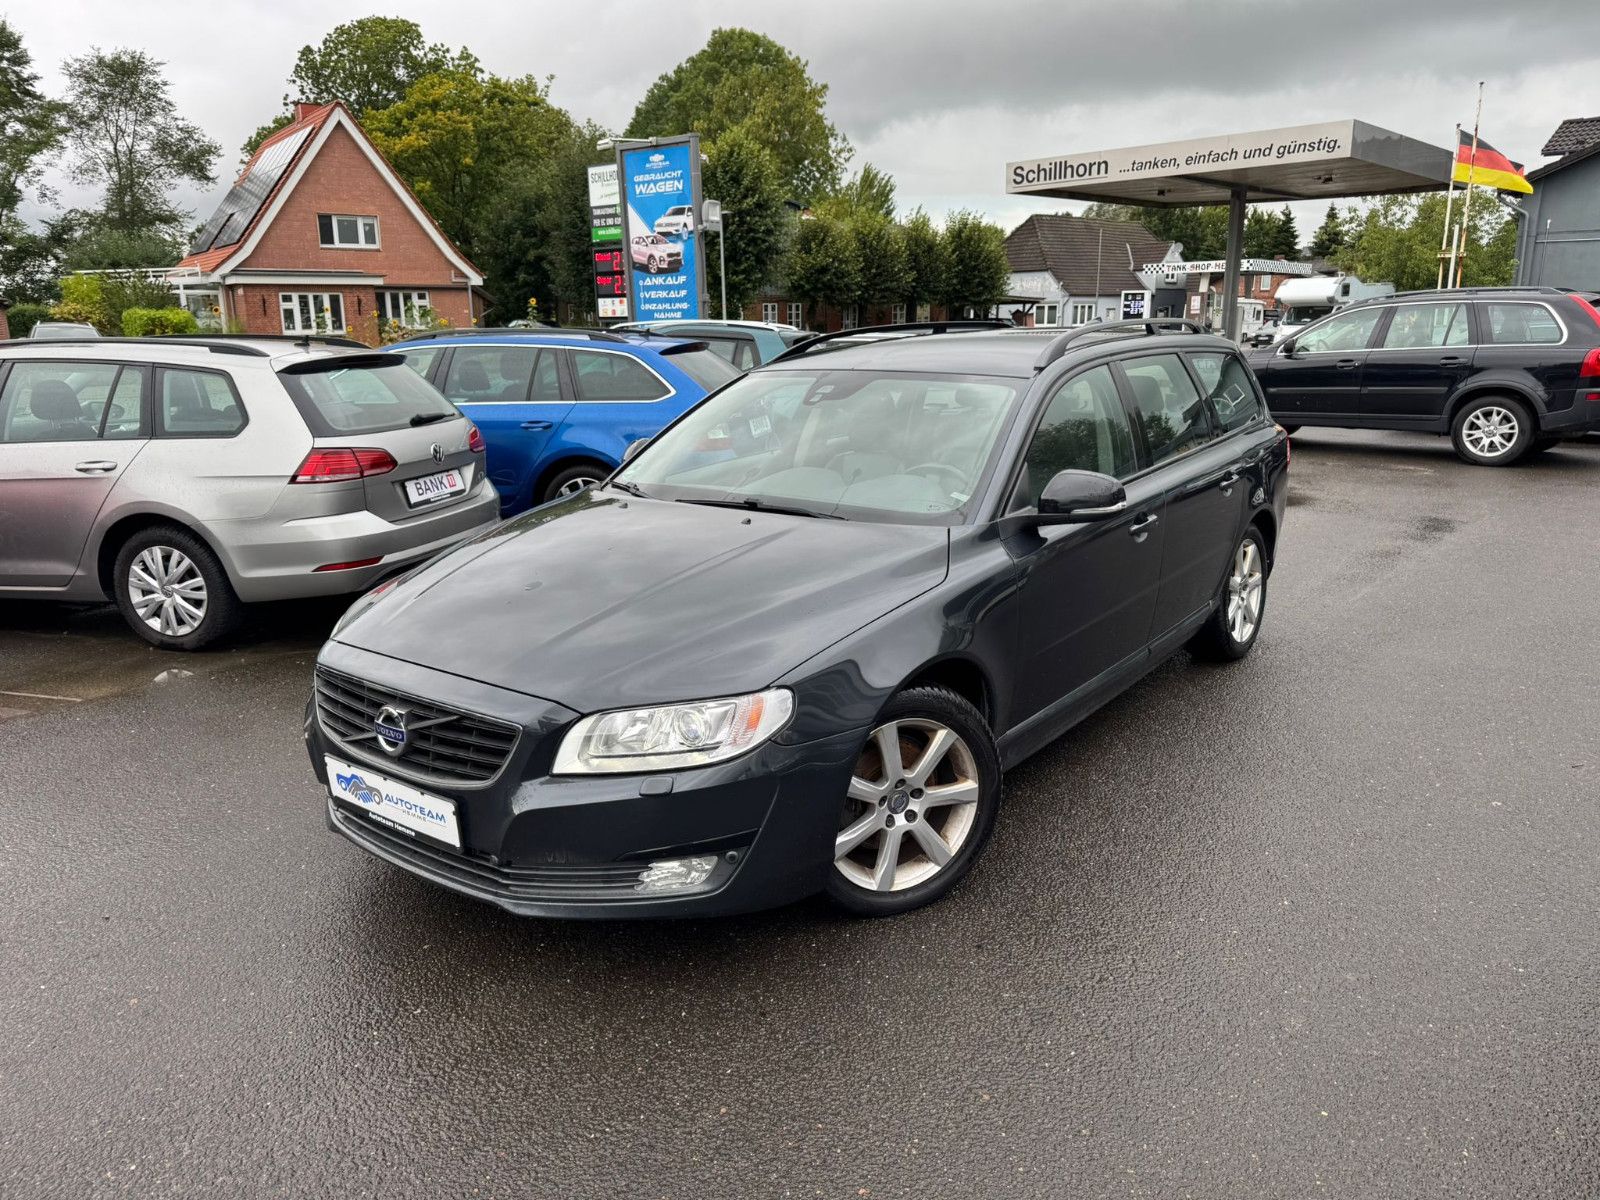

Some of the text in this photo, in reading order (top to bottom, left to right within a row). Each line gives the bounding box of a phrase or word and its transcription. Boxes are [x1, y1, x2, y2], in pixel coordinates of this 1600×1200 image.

[1012, 136, 1341, 185] Schillhorn ...tanken, einfach und günstig.
[634, 170, 682, 182] GEBRAUCHT
[635, 180, 683, 195] WAGEN
[643, 276, 687, 286] ANKAUF
[644, 290, 688, 298] VERKAUF
[414, 476, 447, 497] BANK
[376, 725, 403, 740] VOLVO
[384, 793, 447, 824] AUTOTEAM
[368, 811, 416, 837] Autoteam Hemme
